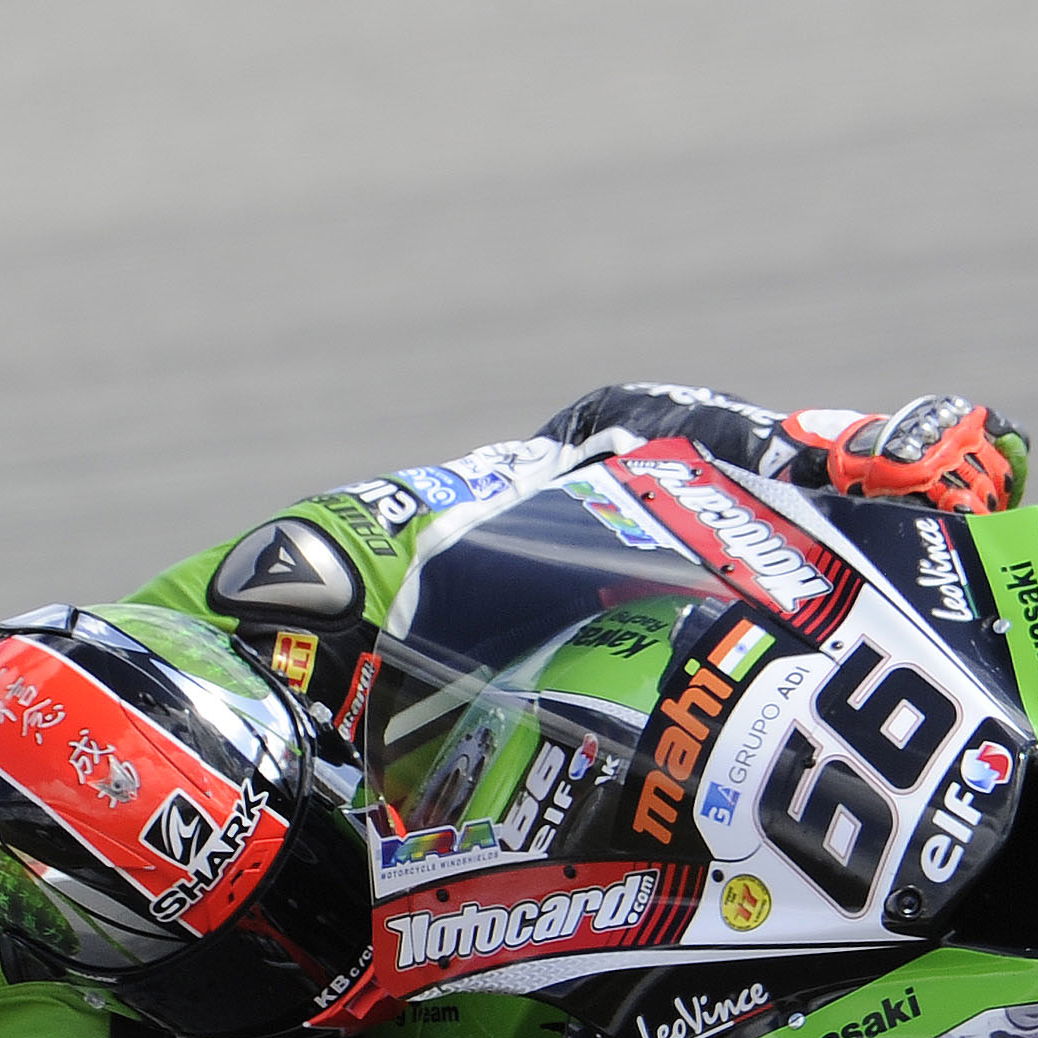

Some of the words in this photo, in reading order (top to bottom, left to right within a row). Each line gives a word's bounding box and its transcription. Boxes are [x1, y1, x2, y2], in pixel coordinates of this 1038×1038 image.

[915, 517, 976, 622] LeoVince
[632, 658, 734, 845] mahi
[729, 703, 781, 785] GRUPO
[778, 665, 811, 701] ADI
[754, 634, 962, 919] 66
[151, 778, 269, 922] SHARK
[380, 865, 437, 880] MOTORCYCLE
[440, 851, 500, 869] WINDSHIELDS
